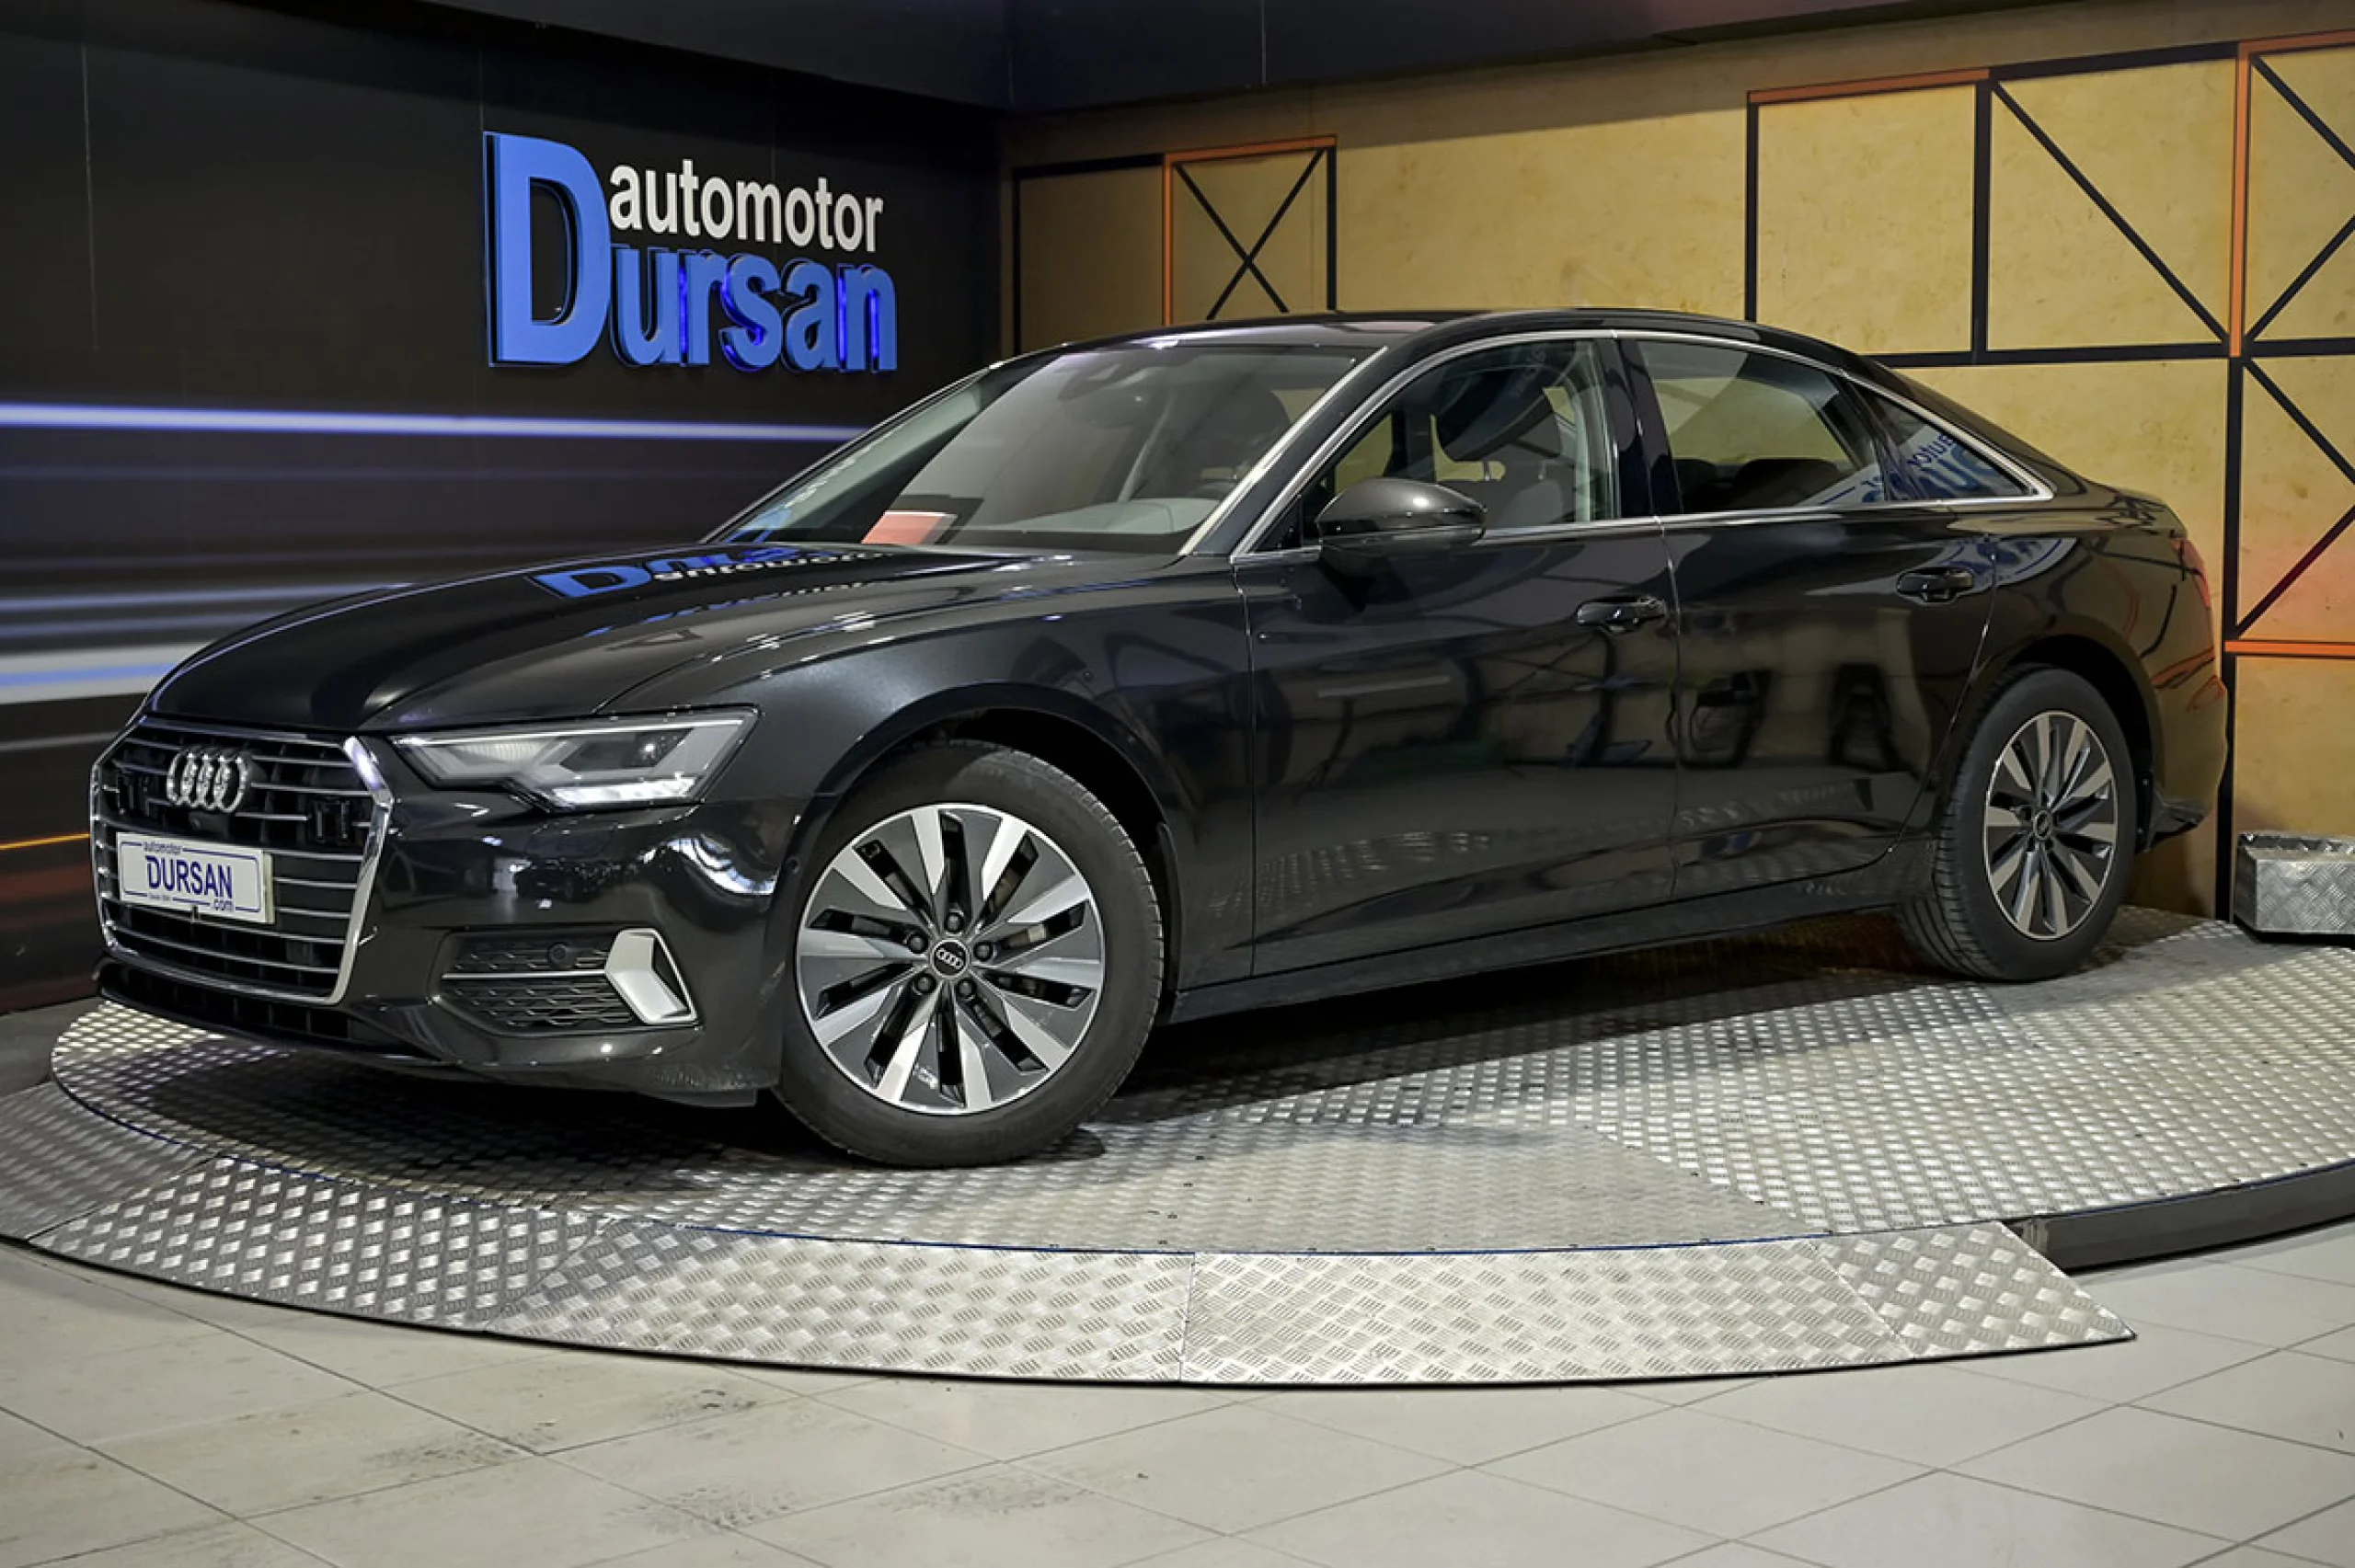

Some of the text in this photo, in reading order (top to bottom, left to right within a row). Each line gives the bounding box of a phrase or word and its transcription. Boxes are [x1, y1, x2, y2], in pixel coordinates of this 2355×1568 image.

[483, 132, 898, 372] Dursan
[609, 158, 884, 253] automotor
[144, 854, 233, 899] DURSAN
